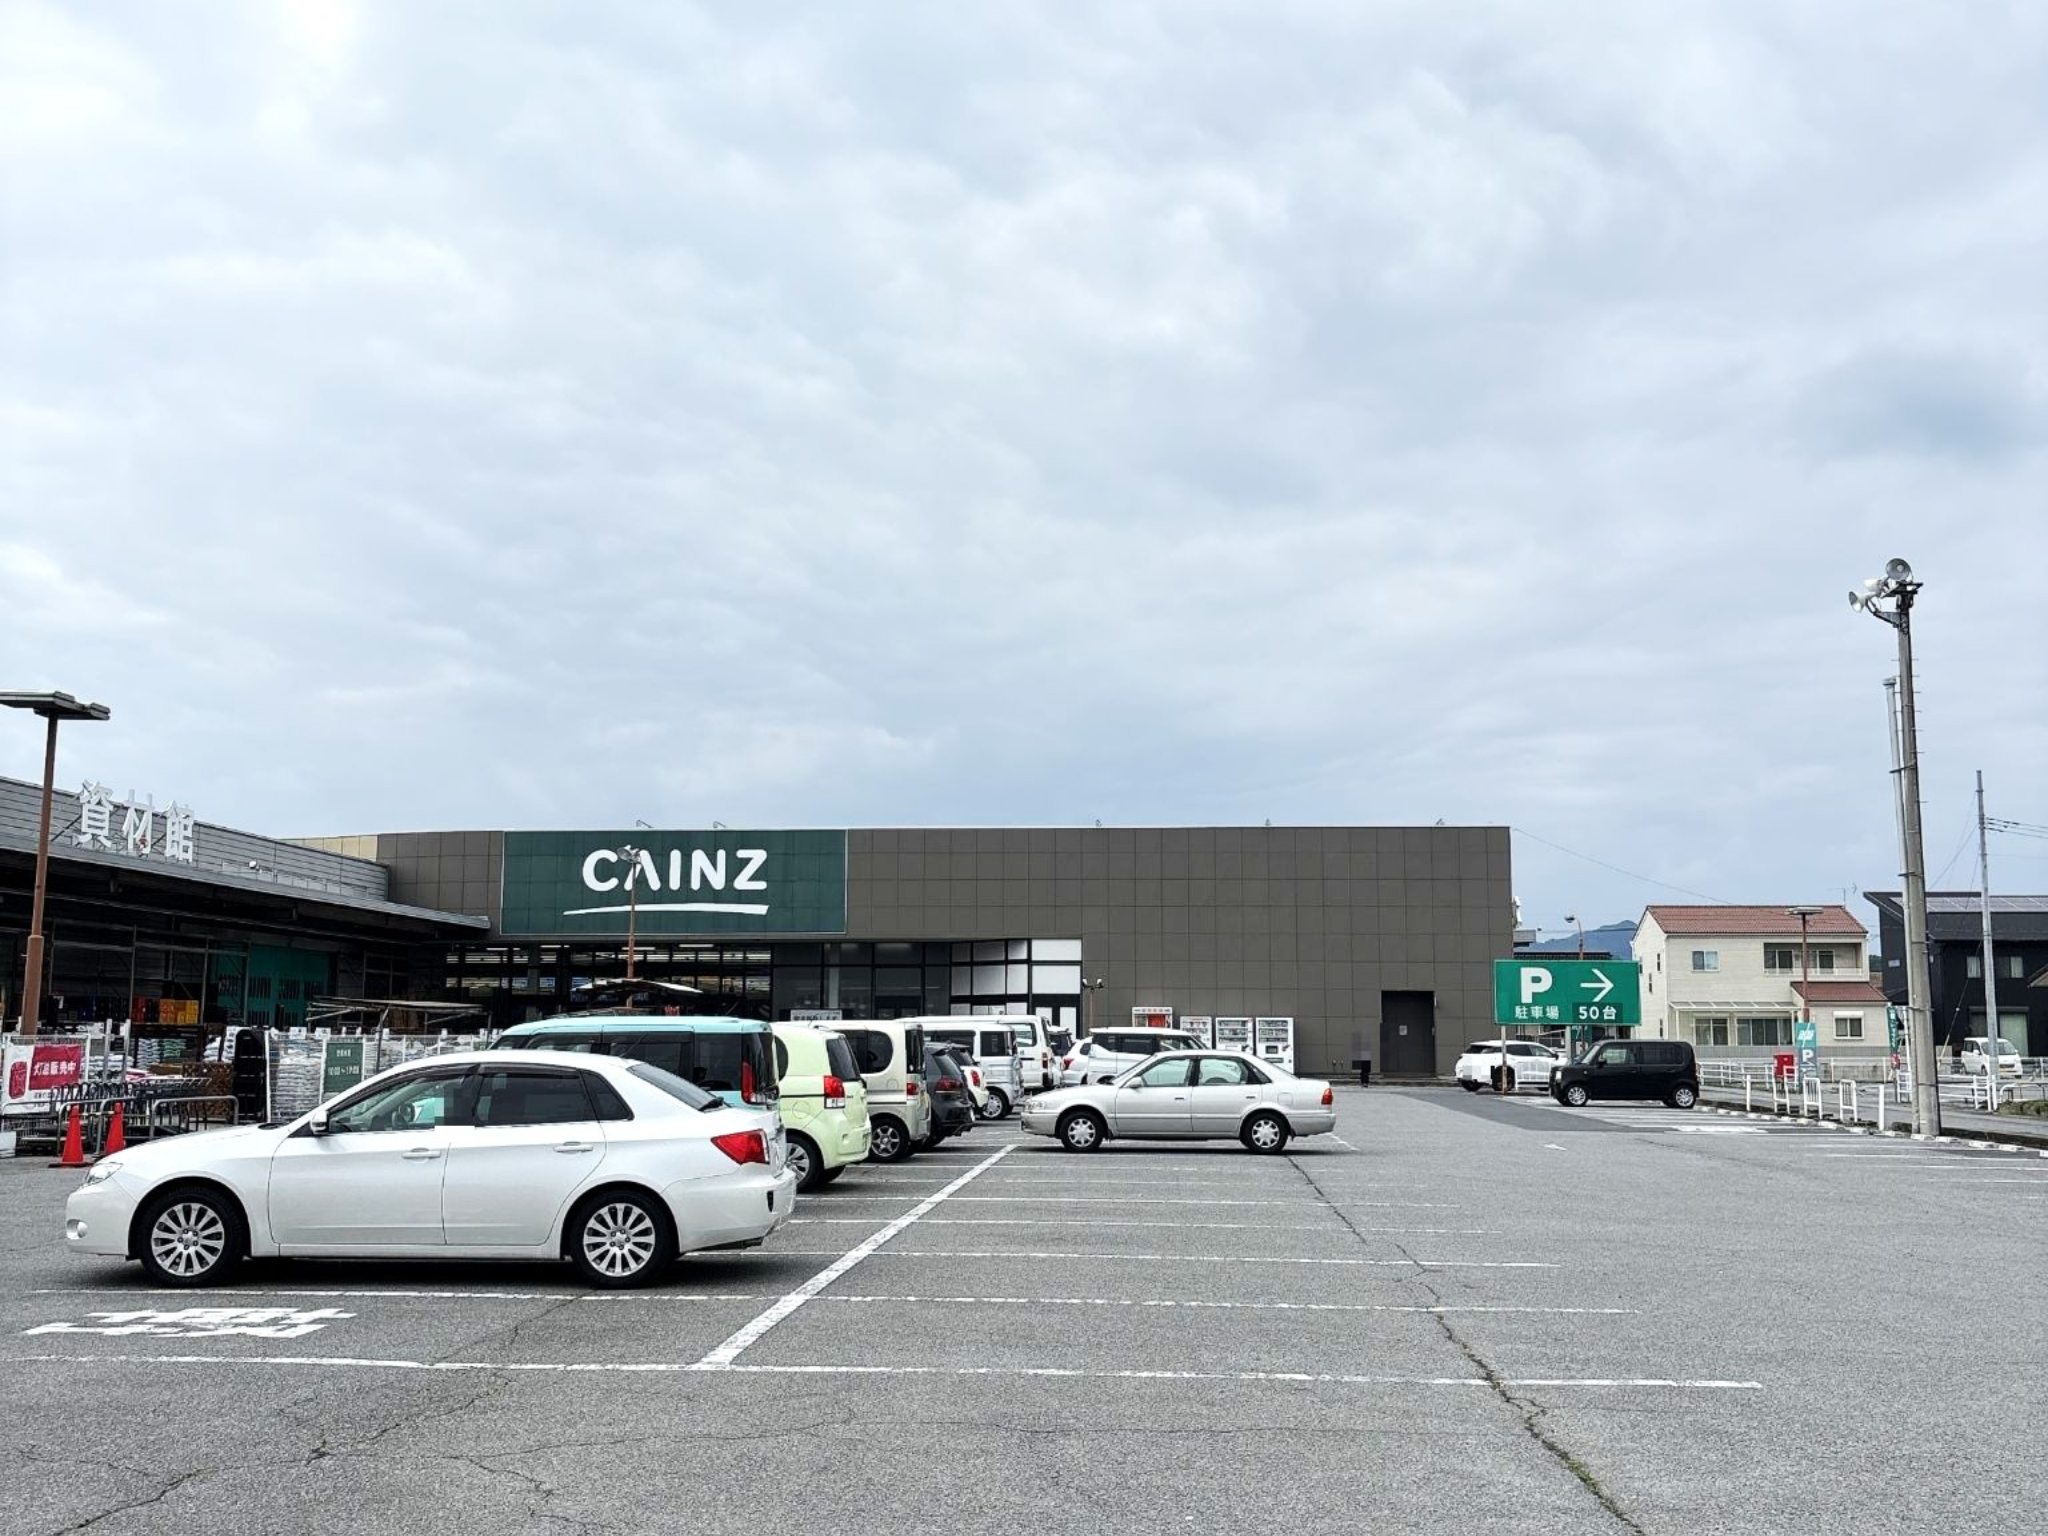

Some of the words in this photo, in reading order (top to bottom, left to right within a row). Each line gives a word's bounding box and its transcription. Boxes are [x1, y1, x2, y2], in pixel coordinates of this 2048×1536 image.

[73, 779, 195, 864] 資材館
[582, 849, 768, 892] CAINZ
[1520, 967, 1553, 1004] P
[1514, 1005, 1560, 1020] 駐車場
[1578, 1005, 1617, 1020] 50台
[1802, 1049, 1814, 1063] P
